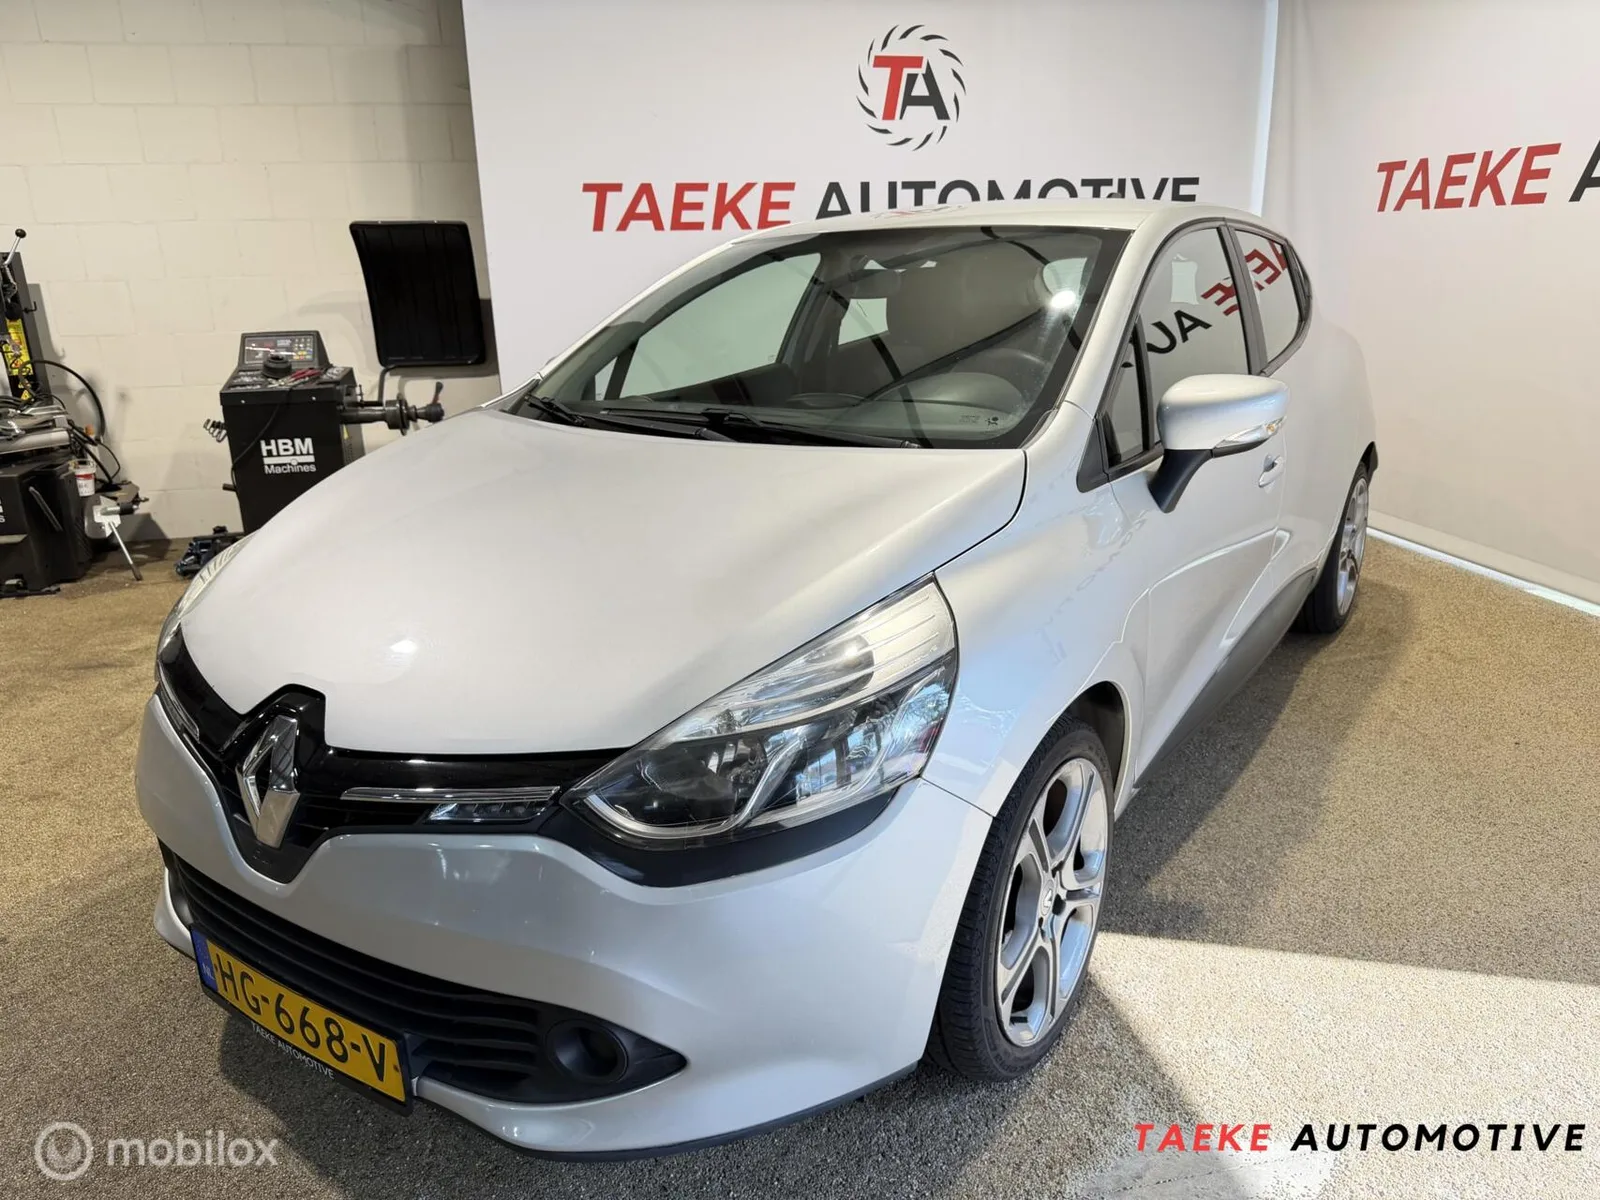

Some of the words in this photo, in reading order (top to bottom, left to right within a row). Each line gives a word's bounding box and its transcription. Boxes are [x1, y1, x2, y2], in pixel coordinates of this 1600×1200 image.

[873, 55, 951, 120] TA
[1377, 143, 1562, 212] TAEKE
[582, 182, 796, 231] TAEKE
[260, 437, 314, 456] HBM
[264, 464, 316, 474] Machines
[202, 963, 215, 981] NL
[216, 953, 386, 1083] HG-668-V
[251, 1021, 276, 1045] TAEKE
[278, 1041, 335, 1080] AUTOMOTIVE
